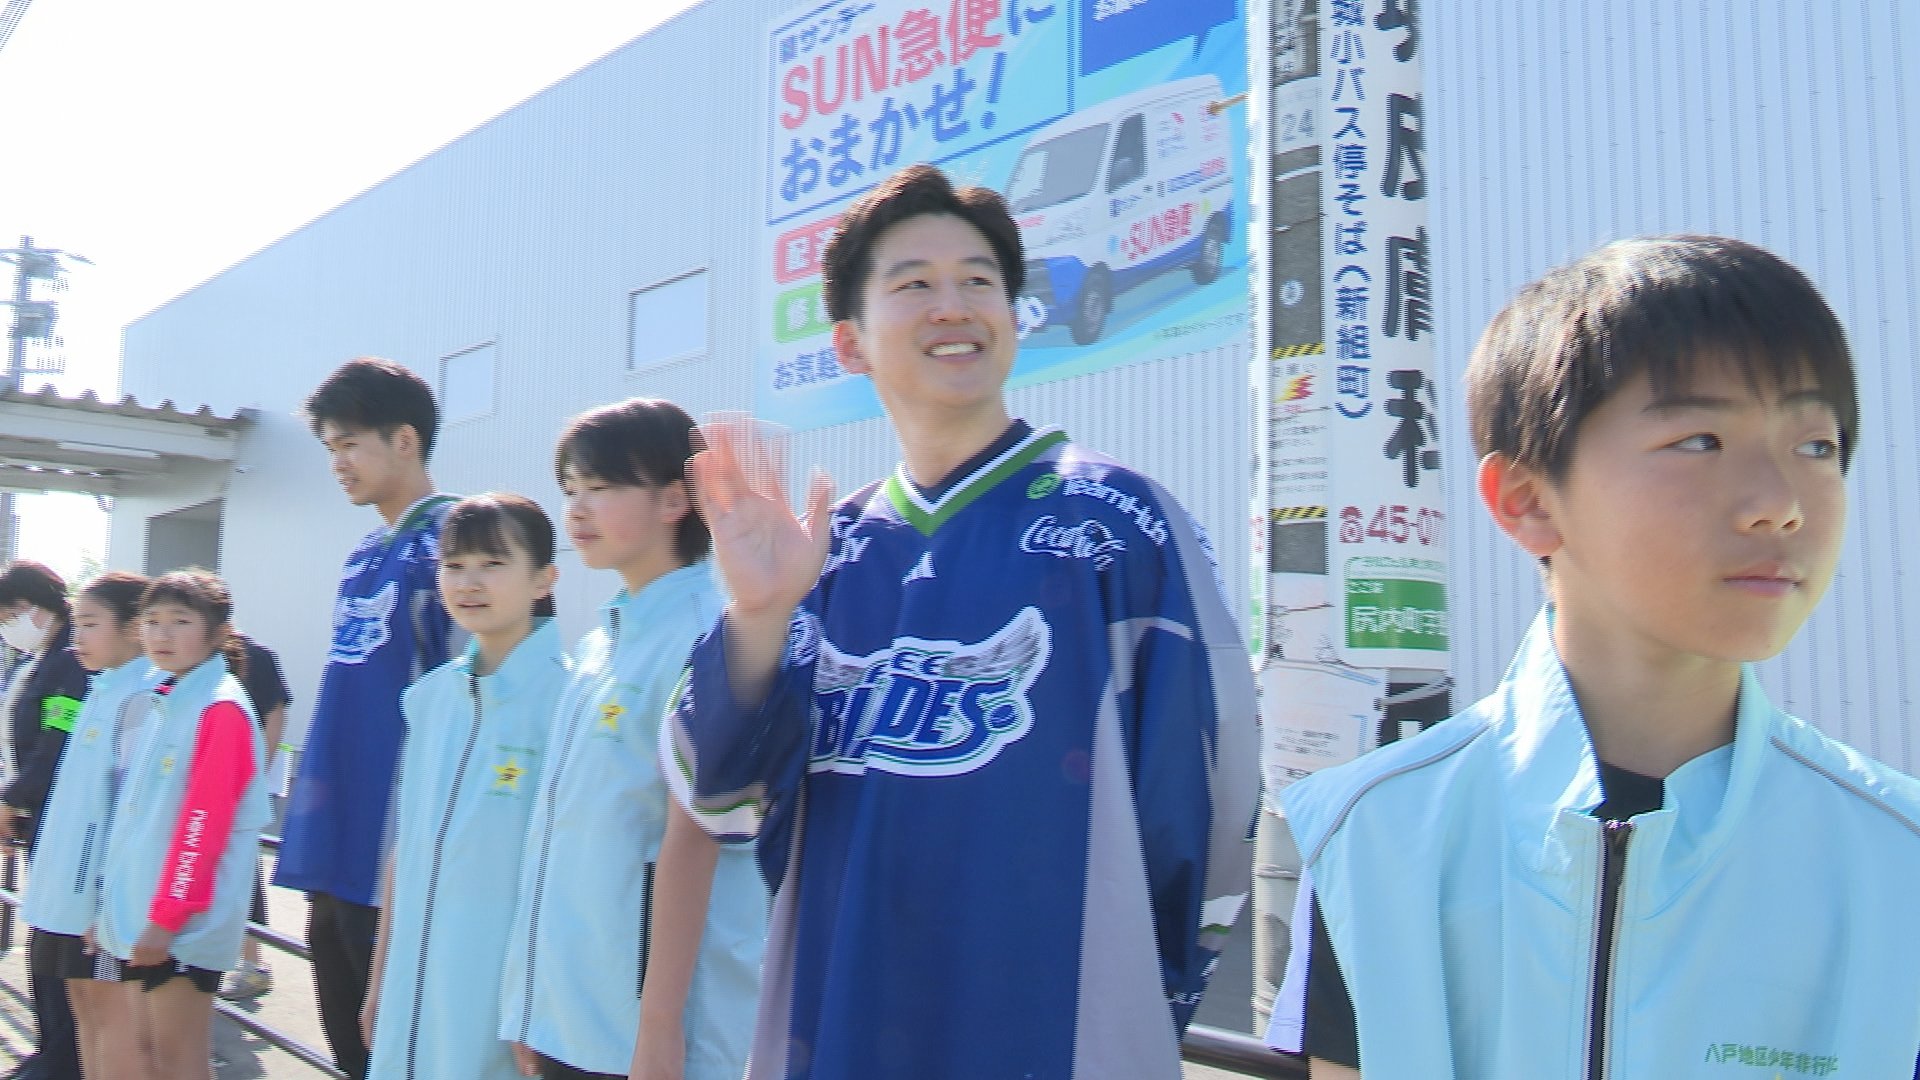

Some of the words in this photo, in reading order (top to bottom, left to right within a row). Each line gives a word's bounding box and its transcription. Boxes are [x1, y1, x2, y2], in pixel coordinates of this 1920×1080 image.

[800, 2, 877, 53] サンデー
[779, 0, 1056, 130] SUN急便に
[1281, 109, 1315, 142] 24
[1062, 477, 1169, 546] TeamHub
[1346, 580, 1384, 594] ここは
[811, 676, 1014, 762] BLDES
[183, 808, 208, 849] new
